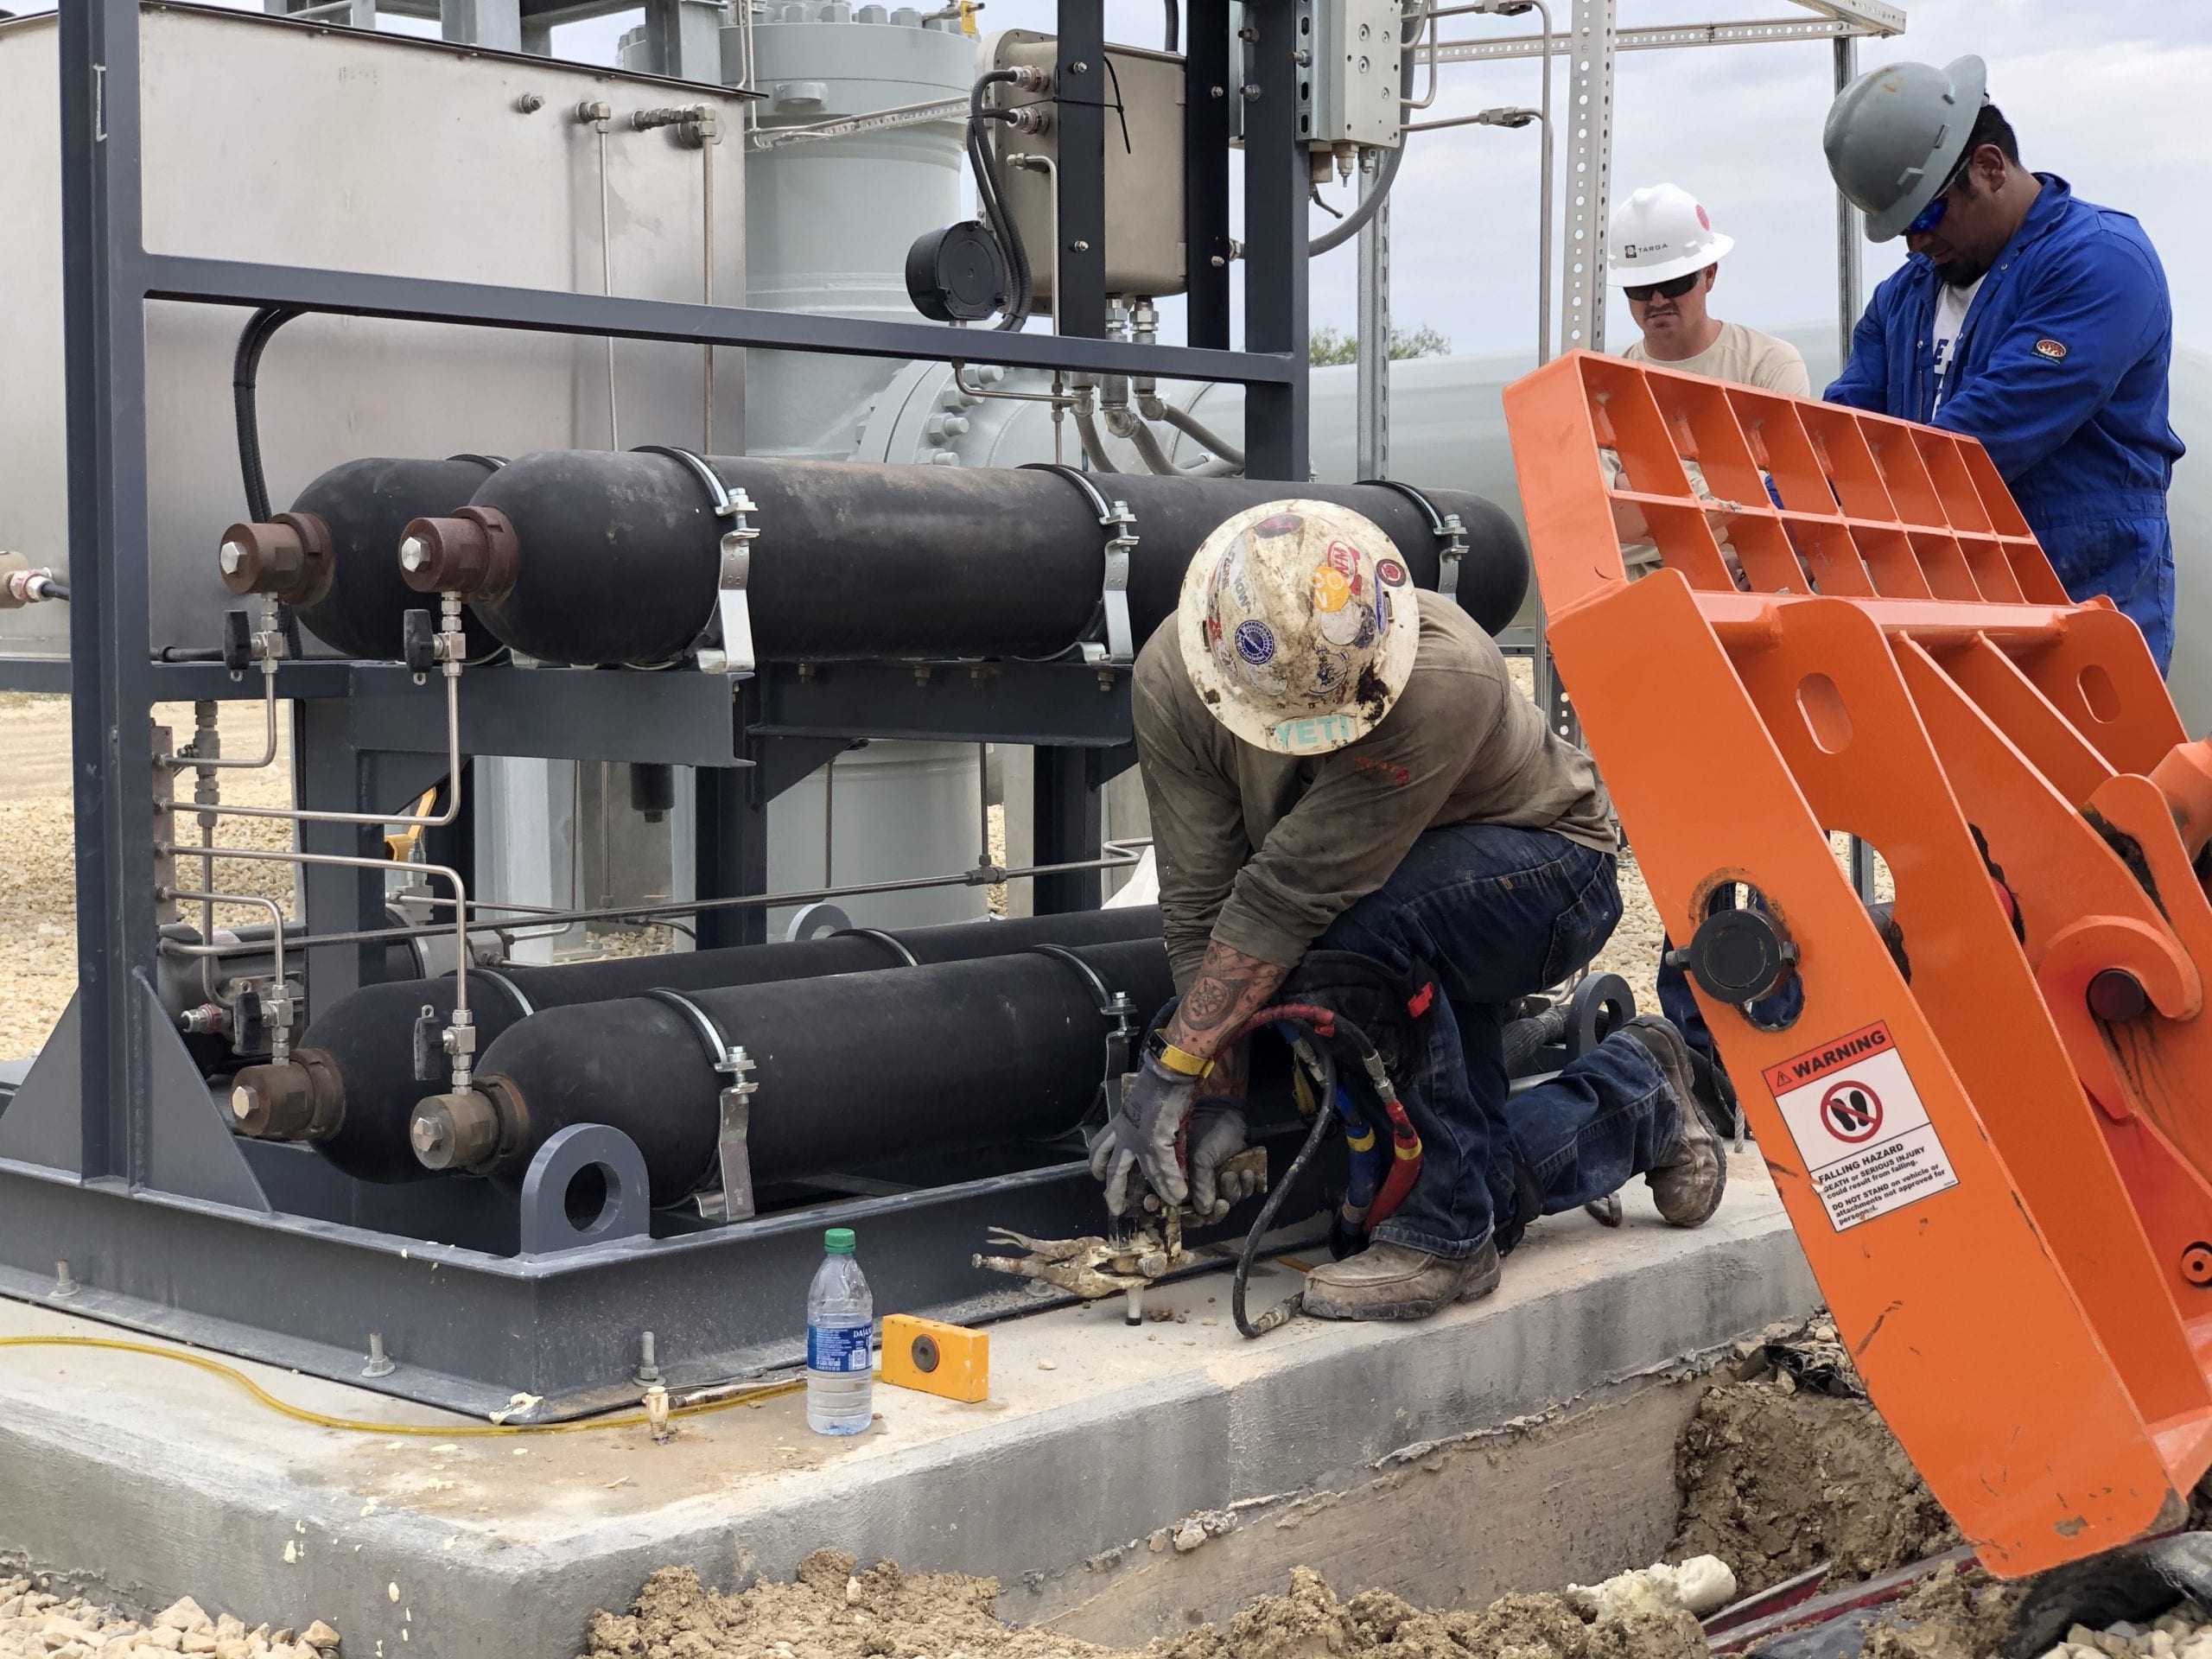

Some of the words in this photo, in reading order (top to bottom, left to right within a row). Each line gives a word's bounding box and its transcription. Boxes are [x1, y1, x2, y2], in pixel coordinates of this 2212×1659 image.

[1638, 243, 1668, 253] TARGA
[1274, 715, 1351, 747] YETI
[1792, 1030, 1886, 1078] WARNING
[1818, 1160, 1860, 1184] FALLING
[1862, 1142, 1904, 1166] HAZARD
[1823, 1178, 1849, 1192] DEATH
[1859, 1159, 1895, 1178] SERIOUS
[1896, 1146, 1925, 1163] INJURY
[1827, 1186, 1847, 1199] could
[1848, 1177, 1871, 1191] result
[1872, 1169, 1891, 1181] from
[1891, 1158, 1918, 1174] falling.
[1832, 1201, 1844, 1211] DO
[1845, 1194, 1862, 1205] NOT
[1862, 1183, 1889, 1198] STAND
[1901, 1166, 1929, 1183] vehicle
[1835, 1194, 1883, 1218] attachments
[1884, 1189, 1897, 1198] not
[1897, 1174, 1934, 1194] approved
[1934, 1168, 1945, 1178] for
